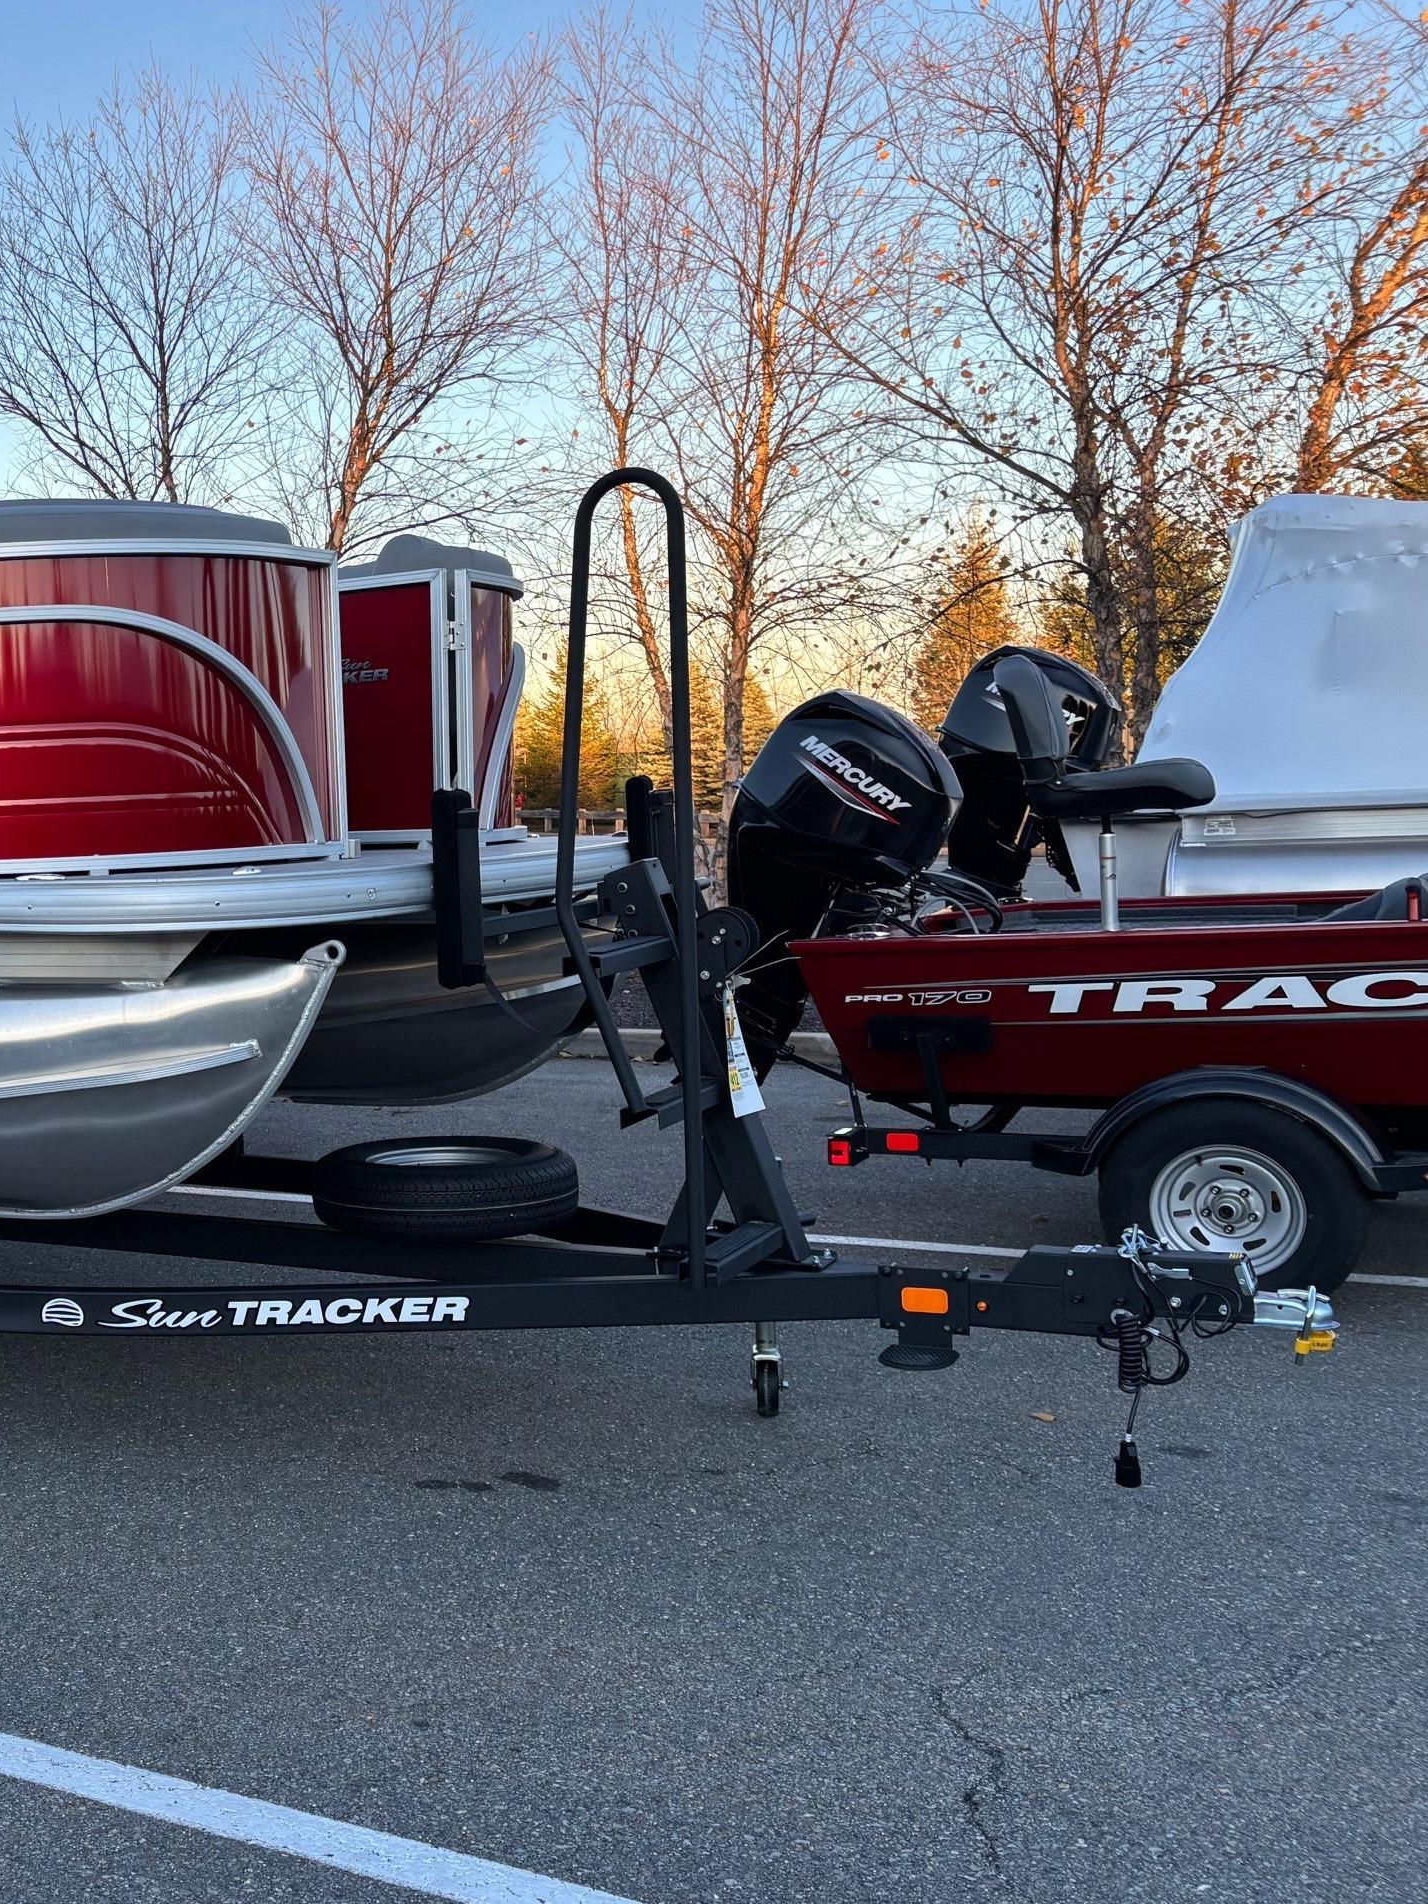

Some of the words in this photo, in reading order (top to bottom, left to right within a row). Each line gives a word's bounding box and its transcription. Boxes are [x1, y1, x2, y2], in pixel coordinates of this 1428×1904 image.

[799, 735, 913, 811] MERCURY
[844, 993, 904, 1003] PRO
[907, 989, 993, 1006] 170
[97, 1299, 222, 1329] Sun
[227, 1296, 470, 1326] TRACKER
